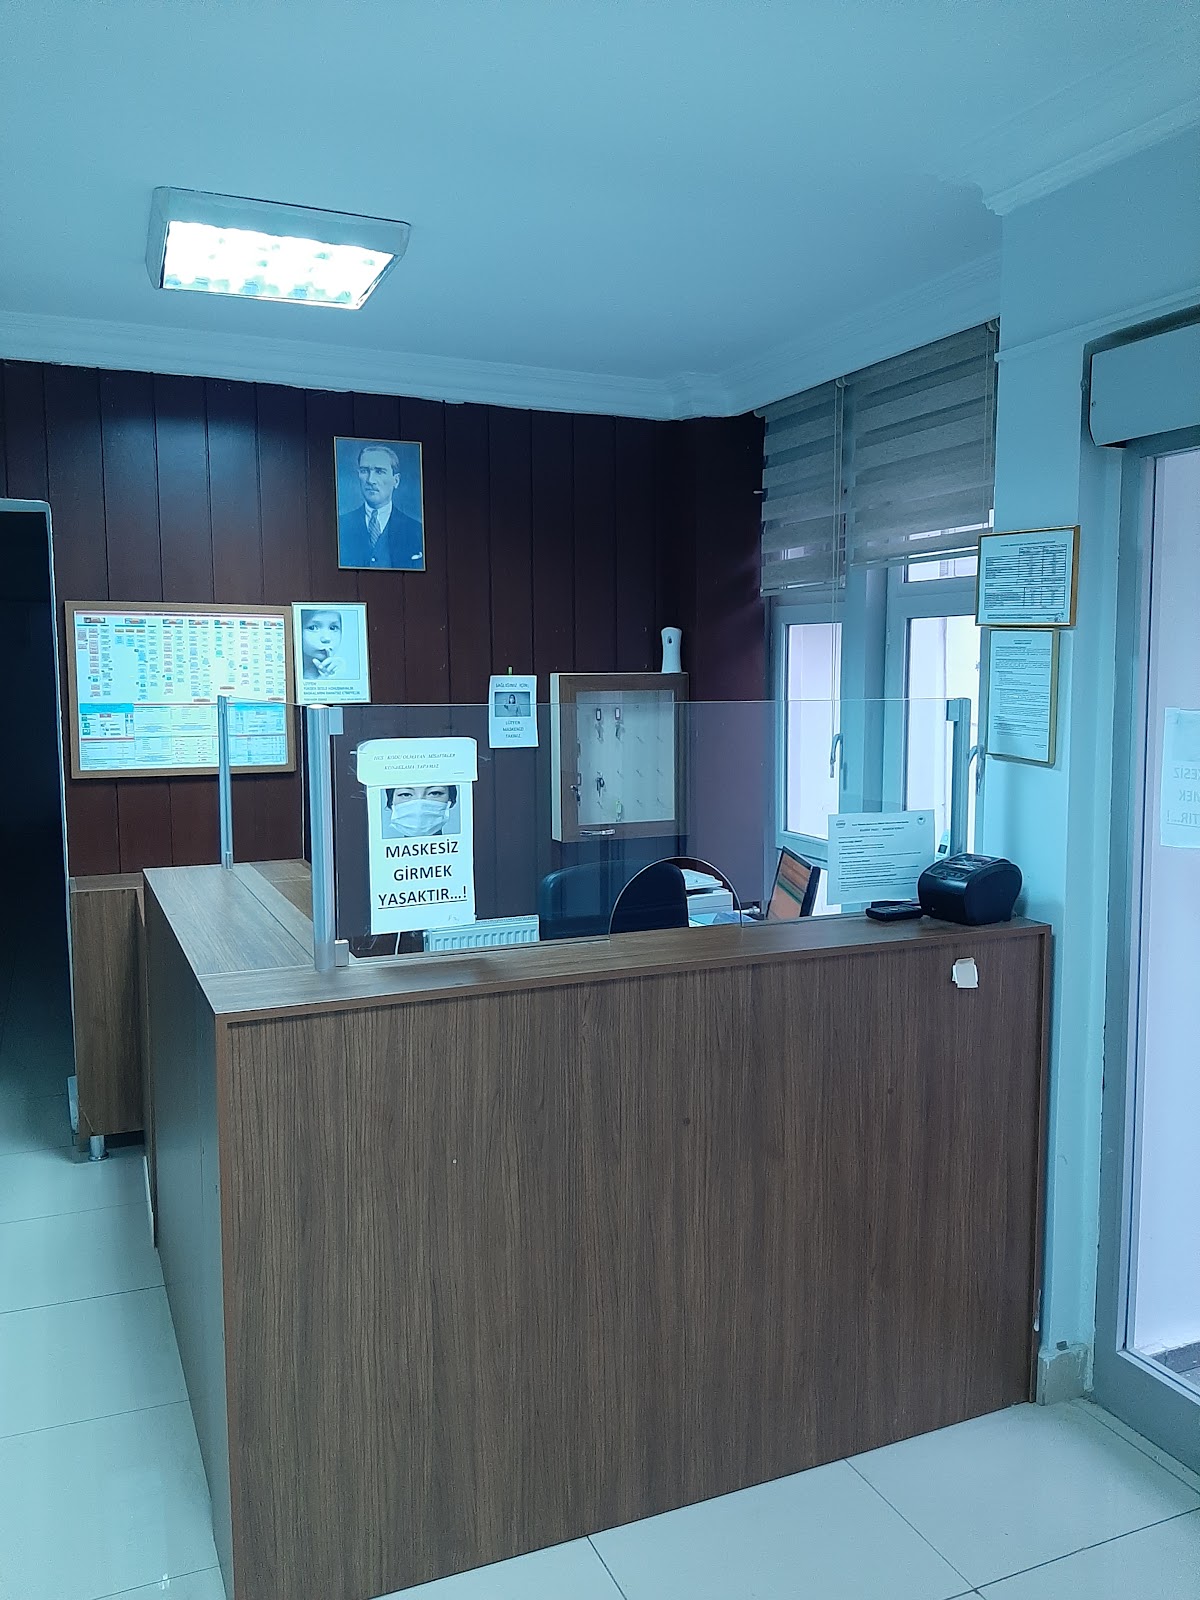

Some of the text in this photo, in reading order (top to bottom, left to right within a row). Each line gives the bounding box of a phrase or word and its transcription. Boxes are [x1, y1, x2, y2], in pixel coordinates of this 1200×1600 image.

[385, 838, 459, 858] MASKESİZ
[393, 864, 453, 882] GİRMEK
[378, 885, 467, 907] YASAKTIR...!
